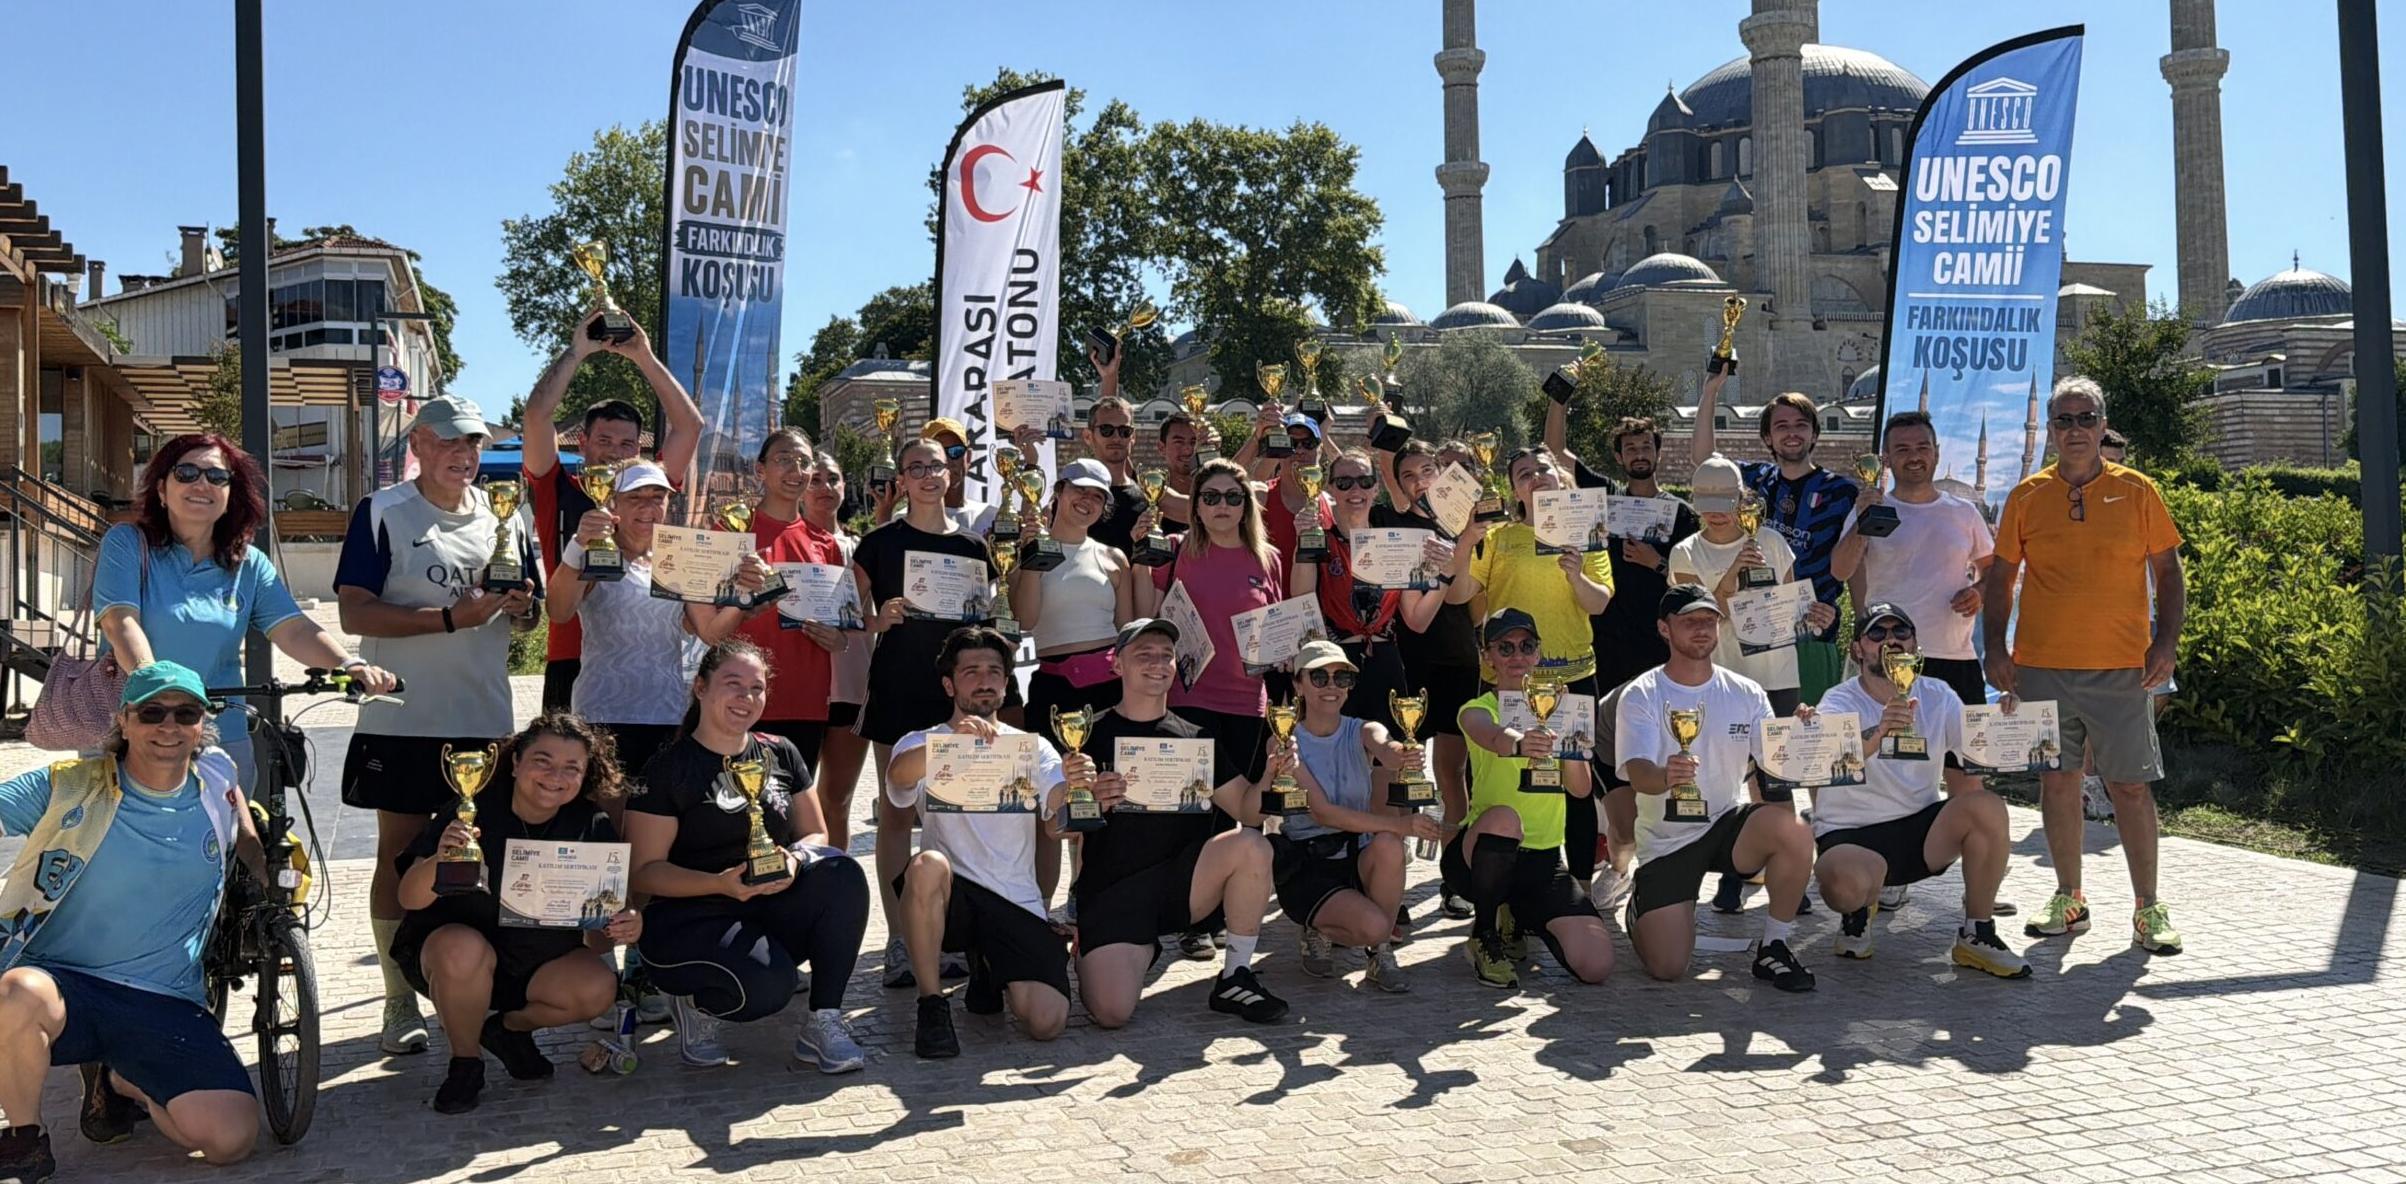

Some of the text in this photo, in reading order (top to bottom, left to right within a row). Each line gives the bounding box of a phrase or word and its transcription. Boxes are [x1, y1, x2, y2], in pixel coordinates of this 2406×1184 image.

[684, 65, 788, 128] UNESCO
[1967, 96, 2032, 131] UNESCO
[683, 165, 783, 226] CAMİ
[1916, 155, 2062, 202] UNESCO
[1913, 203, 2052, 244] SELİMİYE
[681, 258, 775, 309] KOŞUSU
[1933, 245, 2025, 286] CAMİİ
[1906, 305, 2042, 333] FARKINDALIK
[1912, 335, 2028, 381] KOŞUSU
[1763, 519, 1811, 541] etsson
[426, 565, 478, 587] QAT
